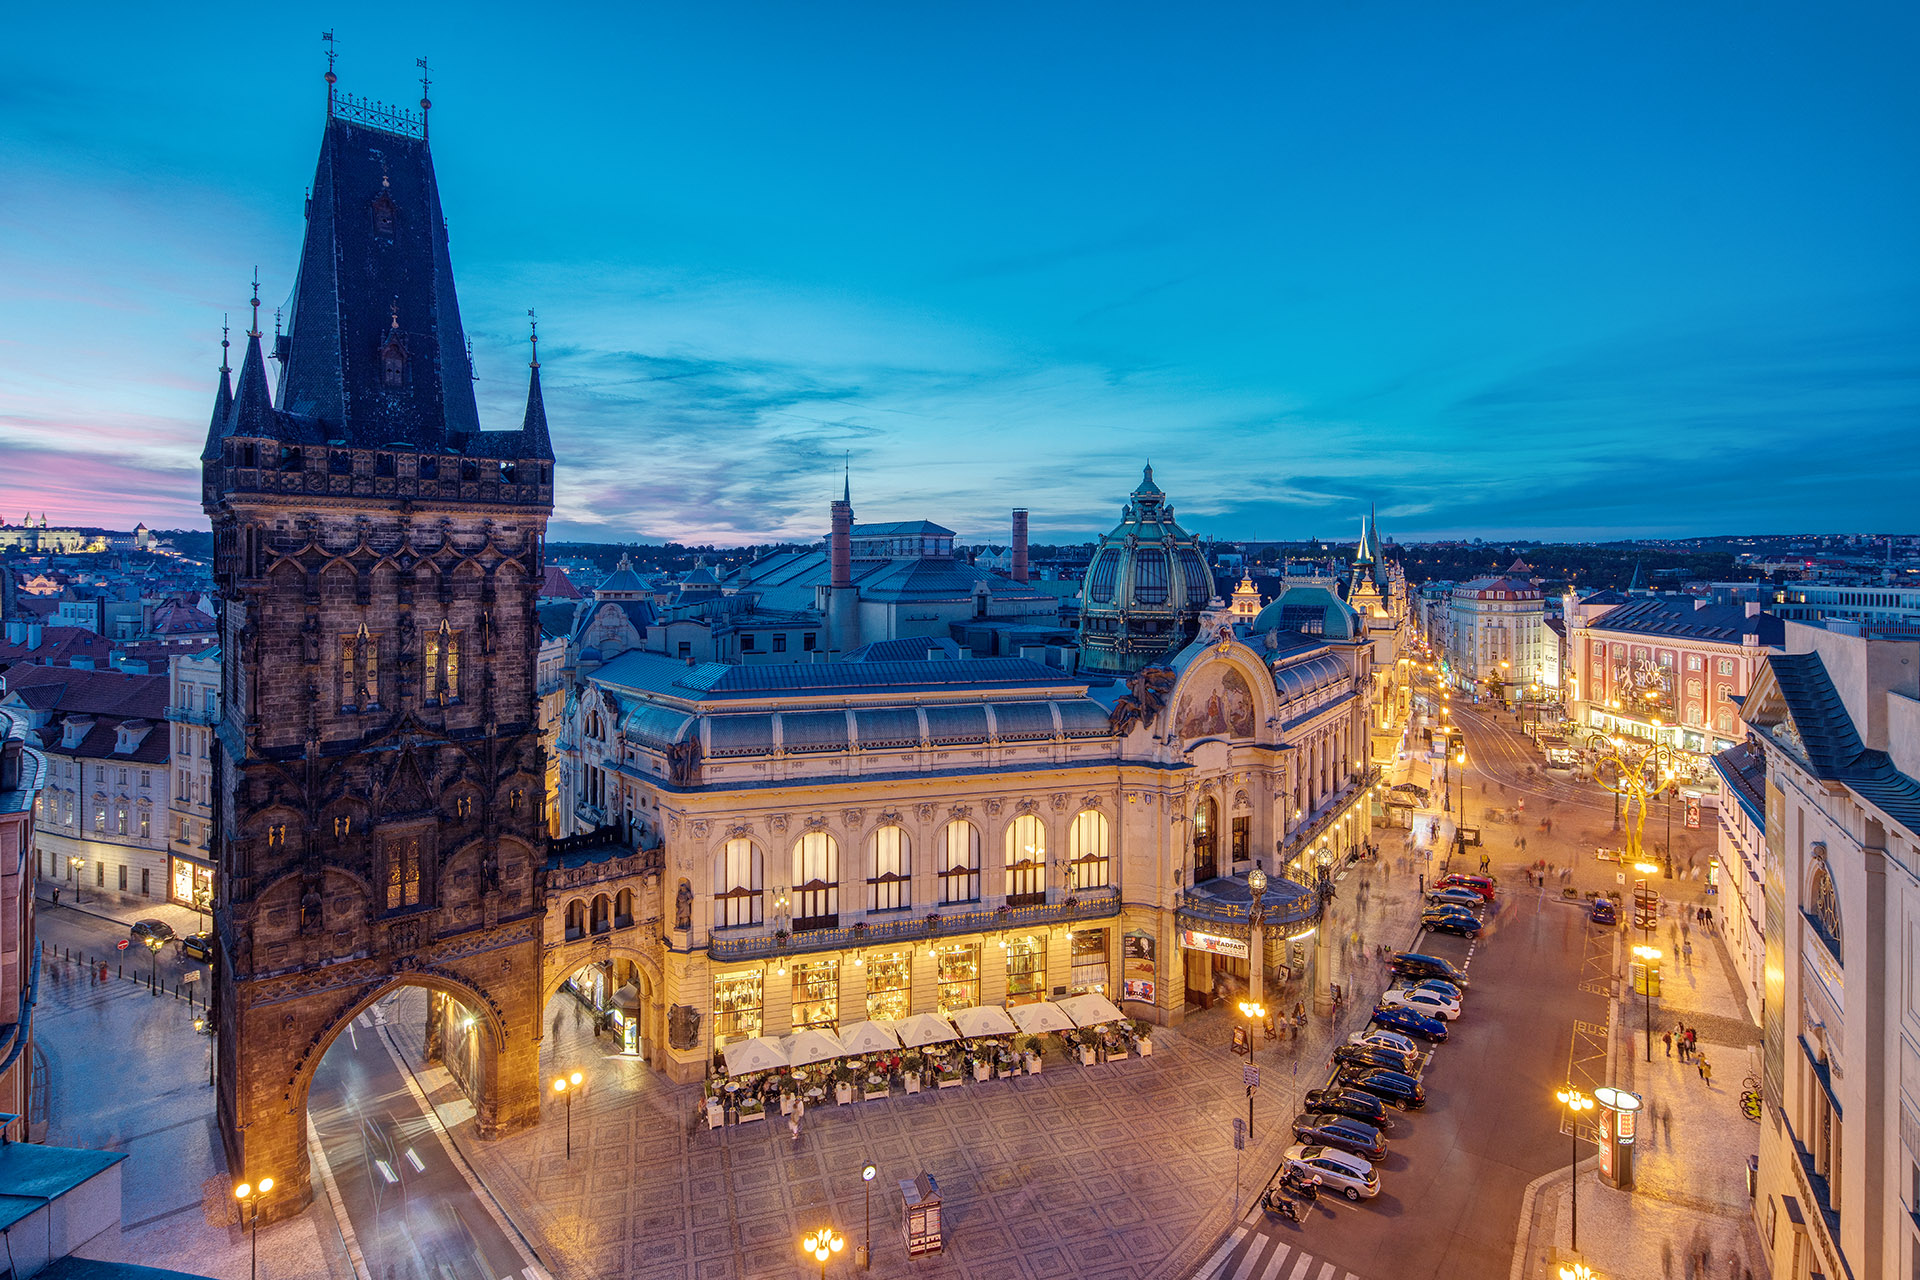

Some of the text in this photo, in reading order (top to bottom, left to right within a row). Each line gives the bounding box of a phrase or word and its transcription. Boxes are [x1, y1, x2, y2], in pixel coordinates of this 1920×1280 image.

[1638, 658, 1658, 672] 200
[1634, 670, 1664, 686] SHOPS
[1578, 1020, 1609, 1039] BUS
